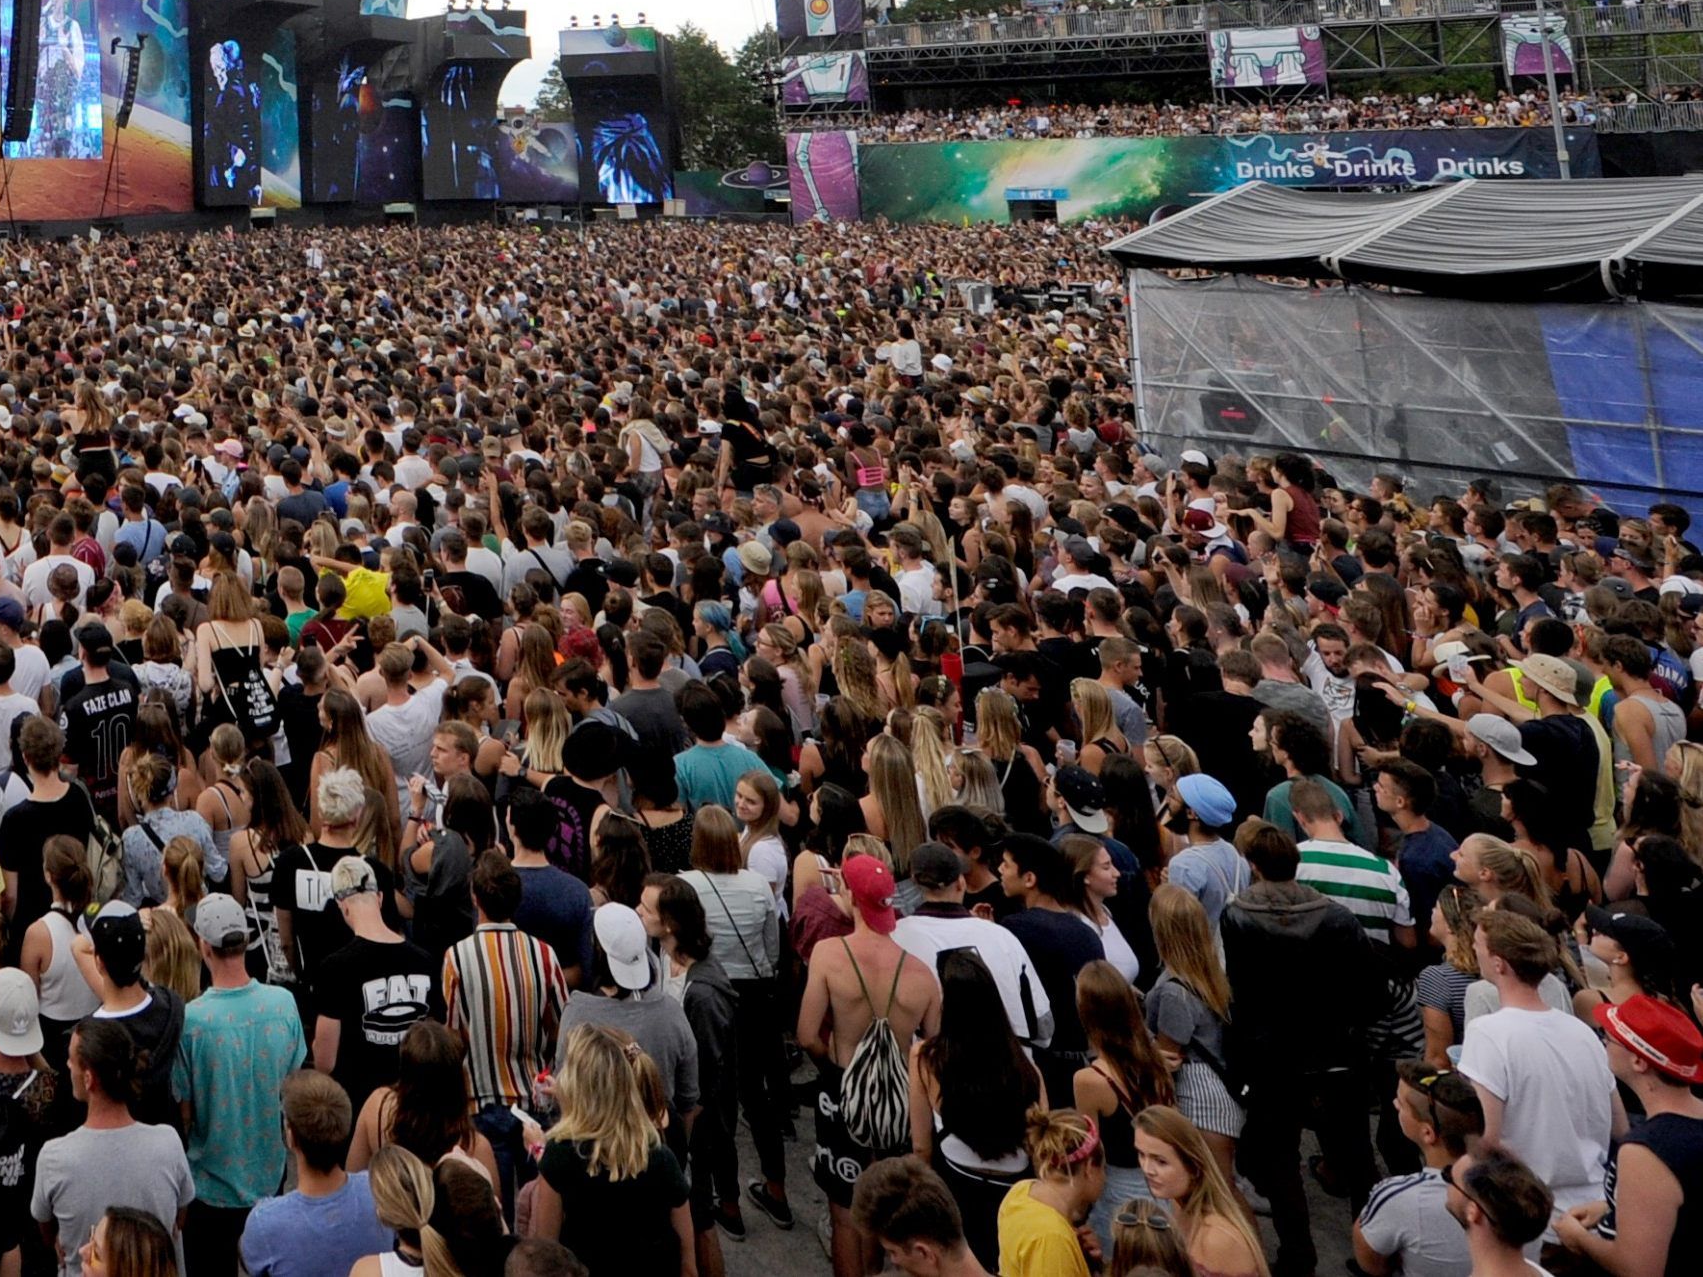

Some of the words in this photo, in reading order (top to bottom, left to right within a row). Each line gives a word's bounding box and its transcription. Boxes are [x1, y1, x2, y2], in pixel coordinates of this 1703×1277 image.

[1236, 161, 1316, 179] Drinks
[1333, 159, 1417, 177] Drinks
[1437, 157, 1525, 176] Drinks
[82, 694, 109, 716] FAZE
[107, 688, 132, 708] CLAN
